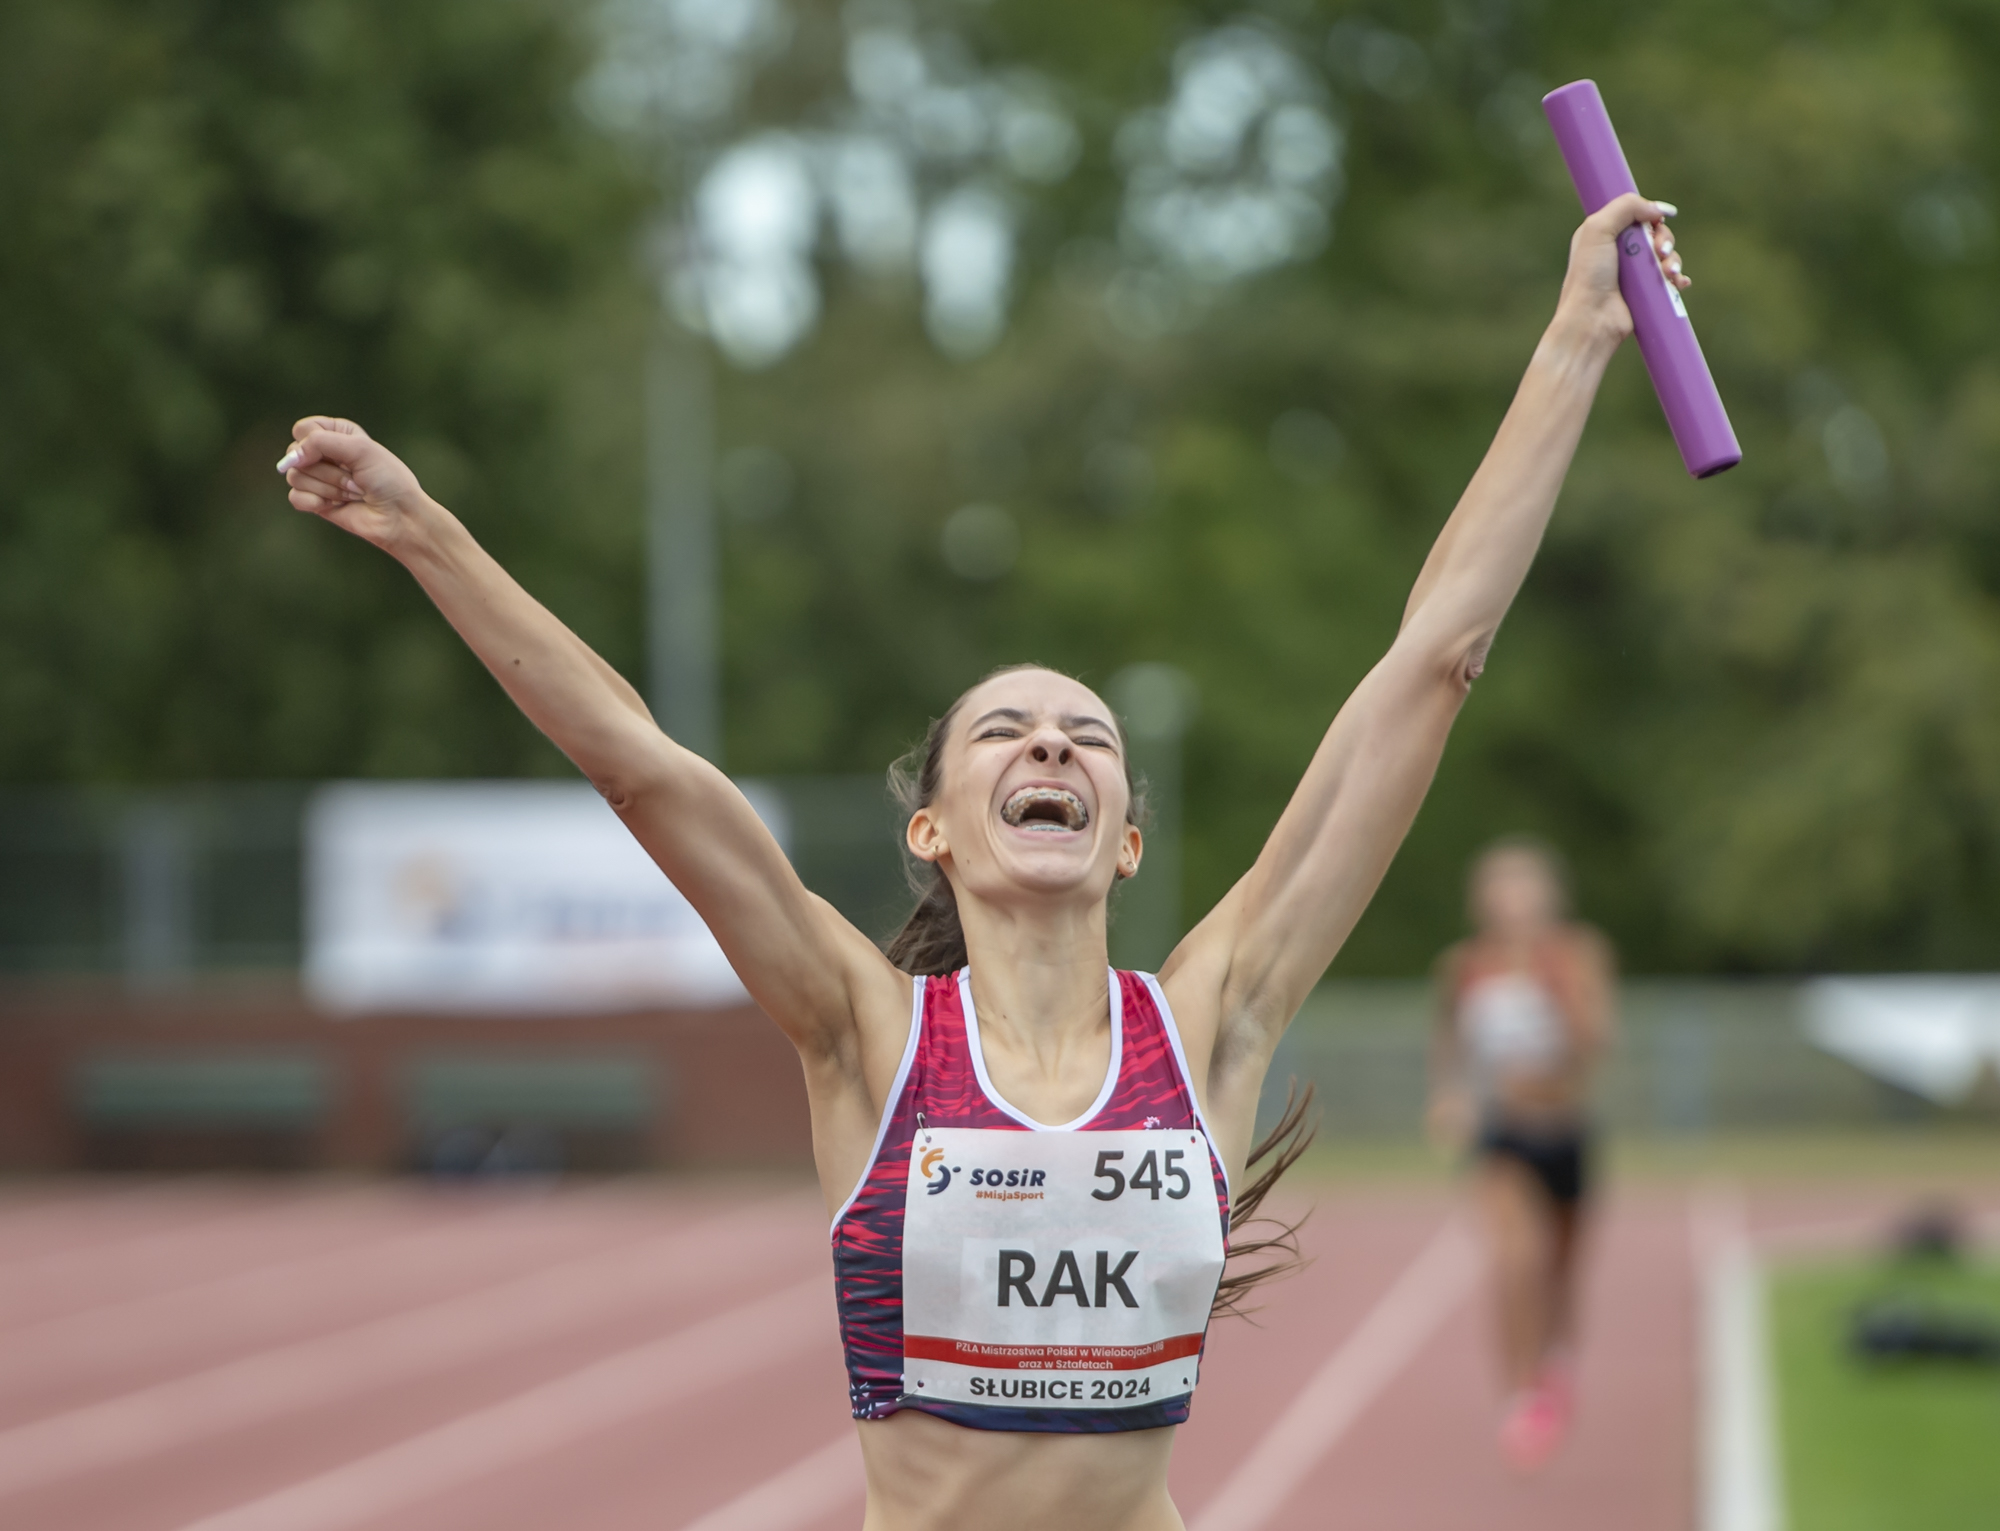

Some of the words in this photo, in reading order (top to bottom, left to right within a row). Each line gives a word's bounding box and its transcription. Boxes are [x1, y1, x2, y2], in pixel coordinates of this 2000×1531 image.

[1091, 1149, 1190, 1201] 545
[975, 1190, 1045, 1202] #MisjaSport
[997, 1249, 1140, 1309] RAK
[956, 1341, 979, 1353] PZLA
[981, 1345, 1045, 1357] Mistrzostwa
[1046, 1346, 1078, 1357] Polski
[1079, 1349, 1089, 1357] w
[1091, 1345, 1152, 1359] Wielobojach
[1018, 1361, 1042, 1370] oraz
[1044, 1361, 1054, 1370] w
[1055, 1359, 1113, 1370] Sztafetach
[969, 1376, 1083, 1399] SŁUBICE
[1090, 1376, 1150, 1399] 2024
